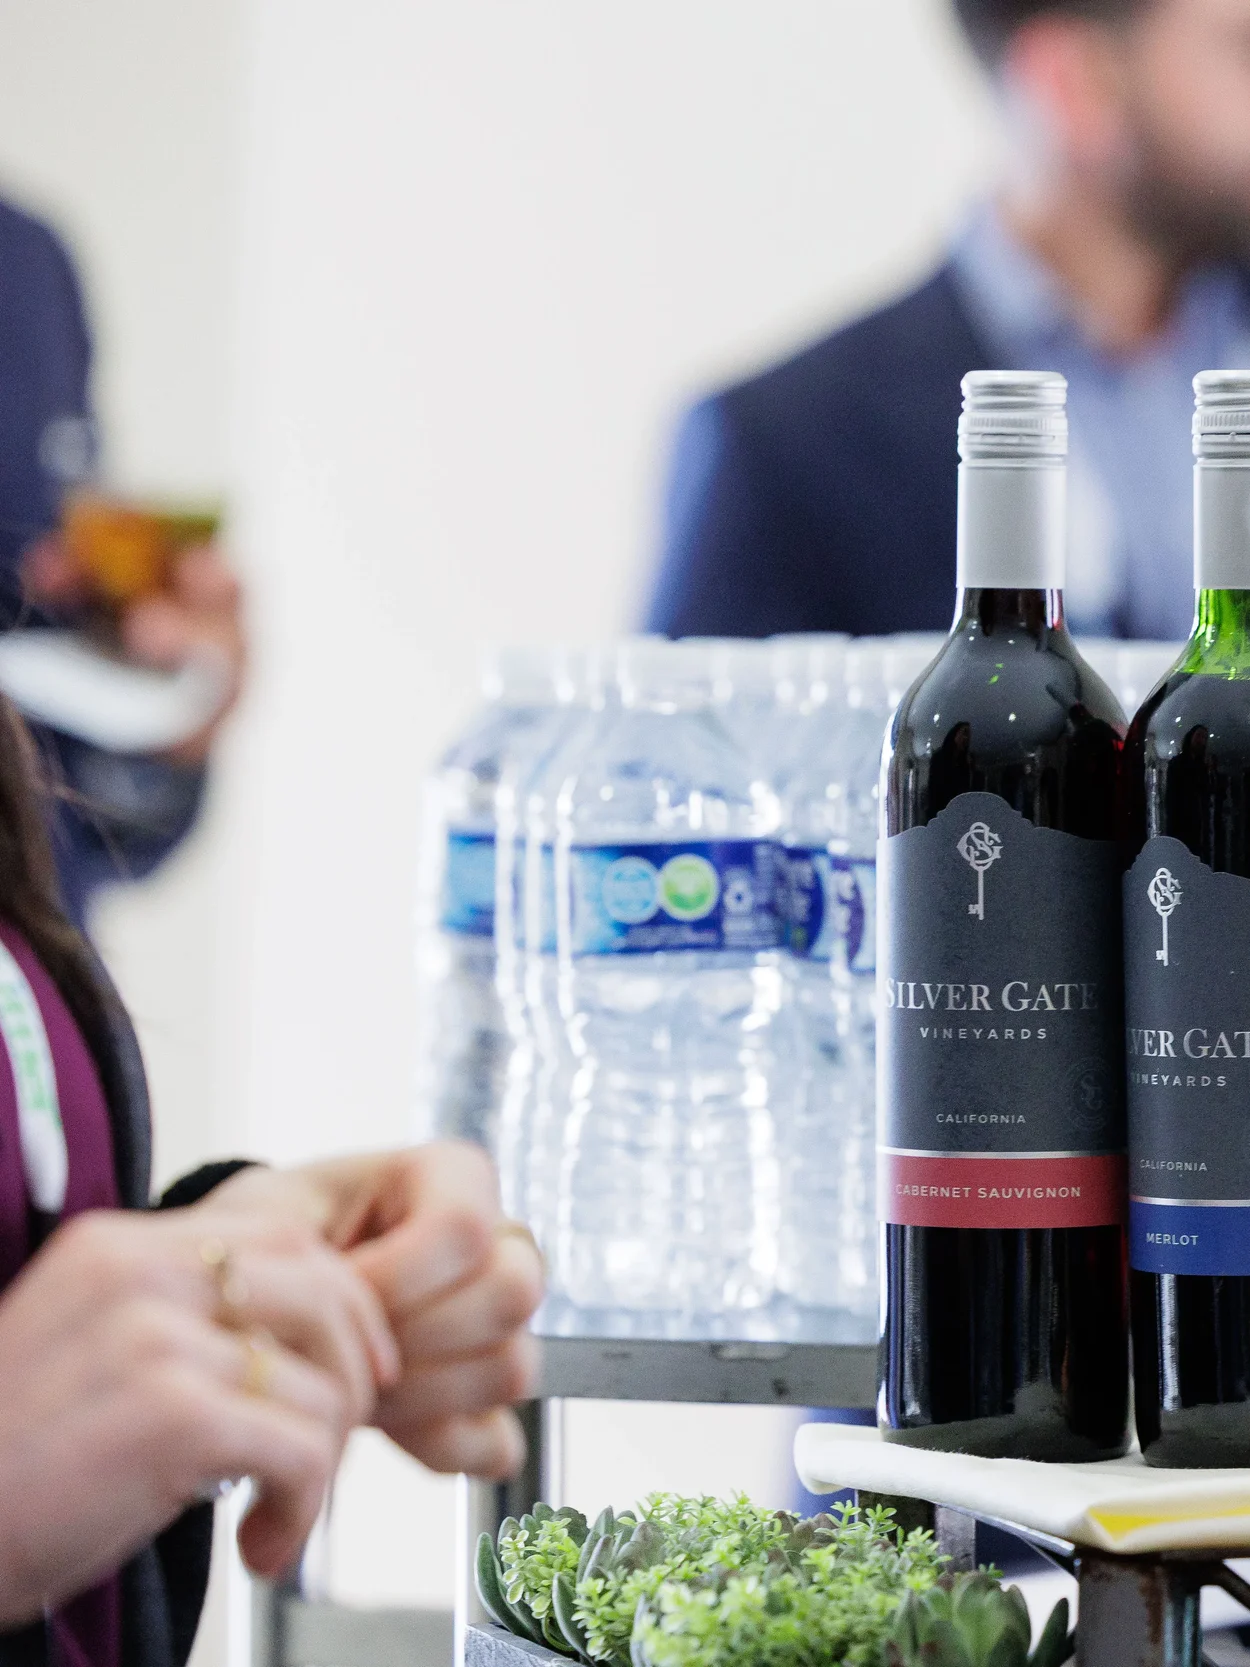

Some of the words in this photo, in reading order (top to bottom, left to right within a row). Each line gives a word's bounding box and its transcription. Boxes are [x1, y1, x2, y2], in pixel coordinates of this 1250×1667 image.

[885, 977, 993, 1011] SILVER
[1001, 981, 1098, 1012] GATE
[920, 1027, 1048, 1040] VINEYARDS
[1129, 1028, 1177, 1058] VER
[936, 1113, 1027, 1125] CALIFORNIA
[1140, 1159, 1208, 1172] CALIFORNIA
[896, 1184, 972, 1198] CABERNET
[978, 1187, 1082, 1199] SAUVIGNON
[1146, 1232, 1199, 1246] MERLOT
